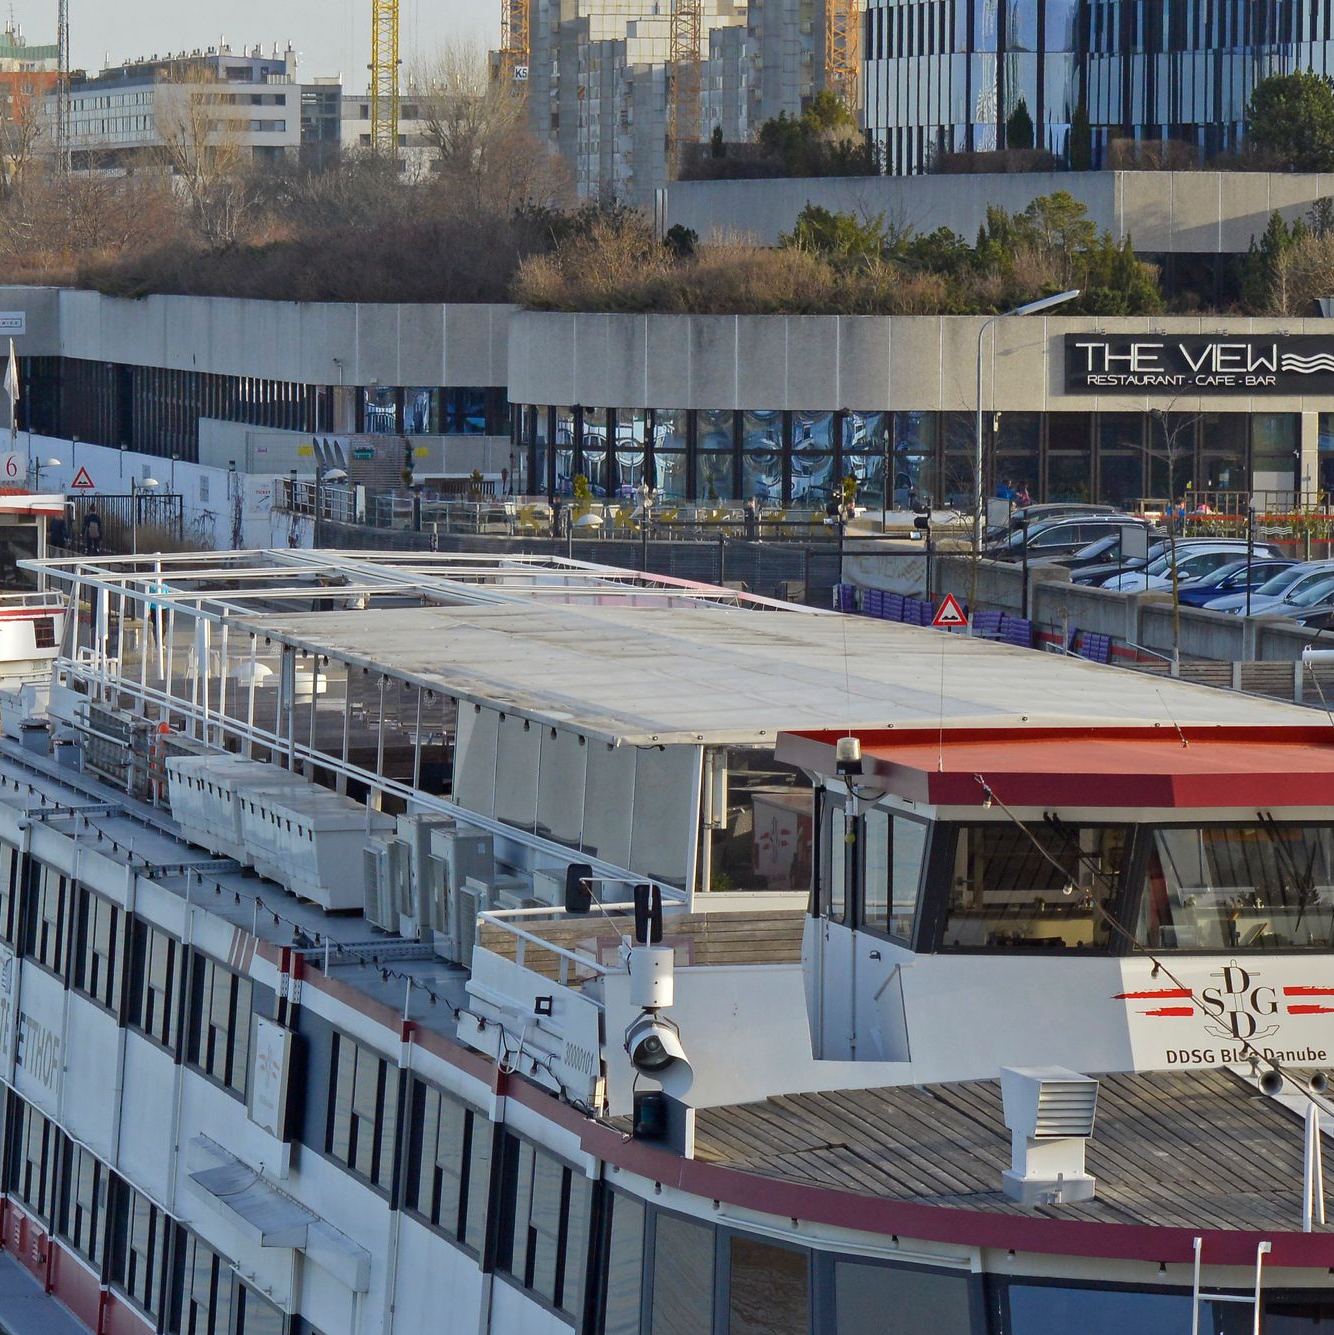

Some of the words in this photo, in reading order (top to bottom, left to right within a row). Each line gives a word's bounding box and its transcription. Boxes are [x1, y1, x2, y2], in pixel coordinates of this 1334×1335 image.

[515, 68, 528, 79] K5
[1075, 342, 1164, 372] THE
[1178, 342, 1277, 373] VIEW
[1087, 374, 1186, 386] RESTAURANT
[1195, 374, 1236, 386] CAFE
[1245, 374, 1277, 386] BAR
[6, 455, 18, 477] 6
[1166, 1049, 1215, 1064] DDSG
[1263, 1047, 1327, 1064] Danube
